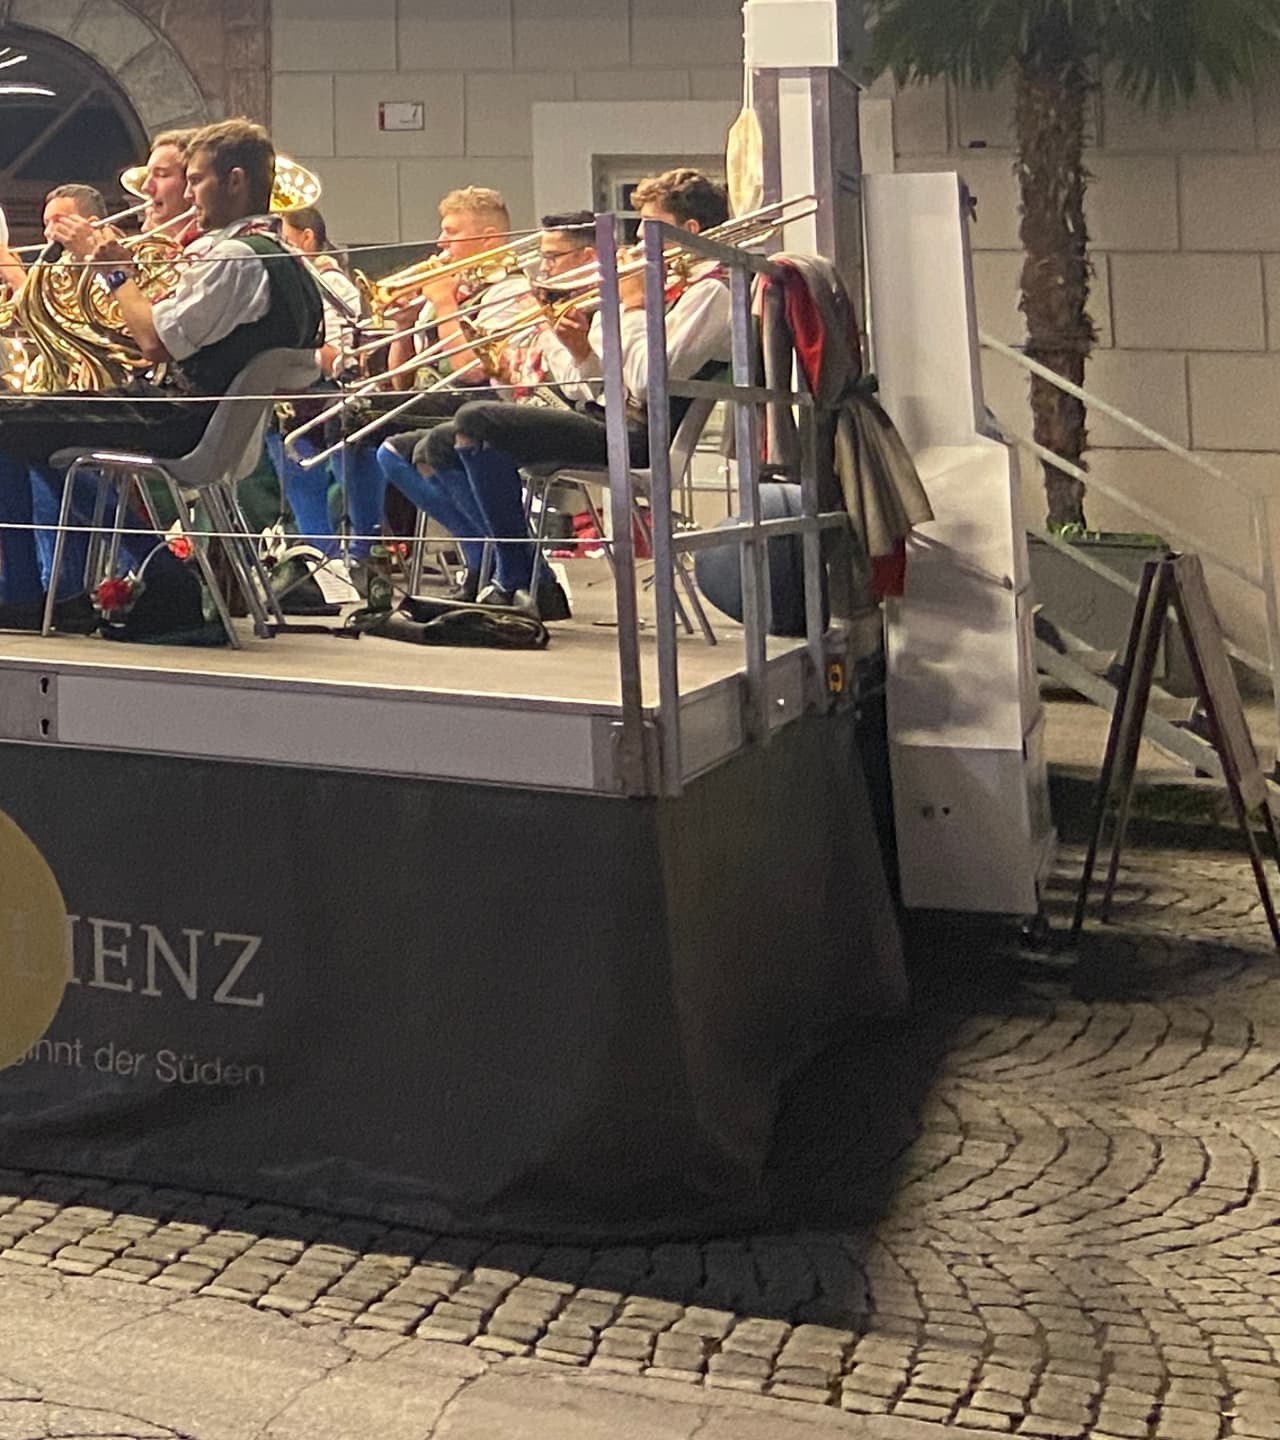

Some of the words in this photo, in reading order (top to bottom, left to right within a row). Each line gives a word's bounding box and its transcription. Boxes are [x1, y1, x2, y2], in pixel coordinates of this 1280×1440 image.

[64, 913, 265, 1008] IENZ
[93, 1041, 146, 1078] der
[155, 1048, 266, 1087] Süden
